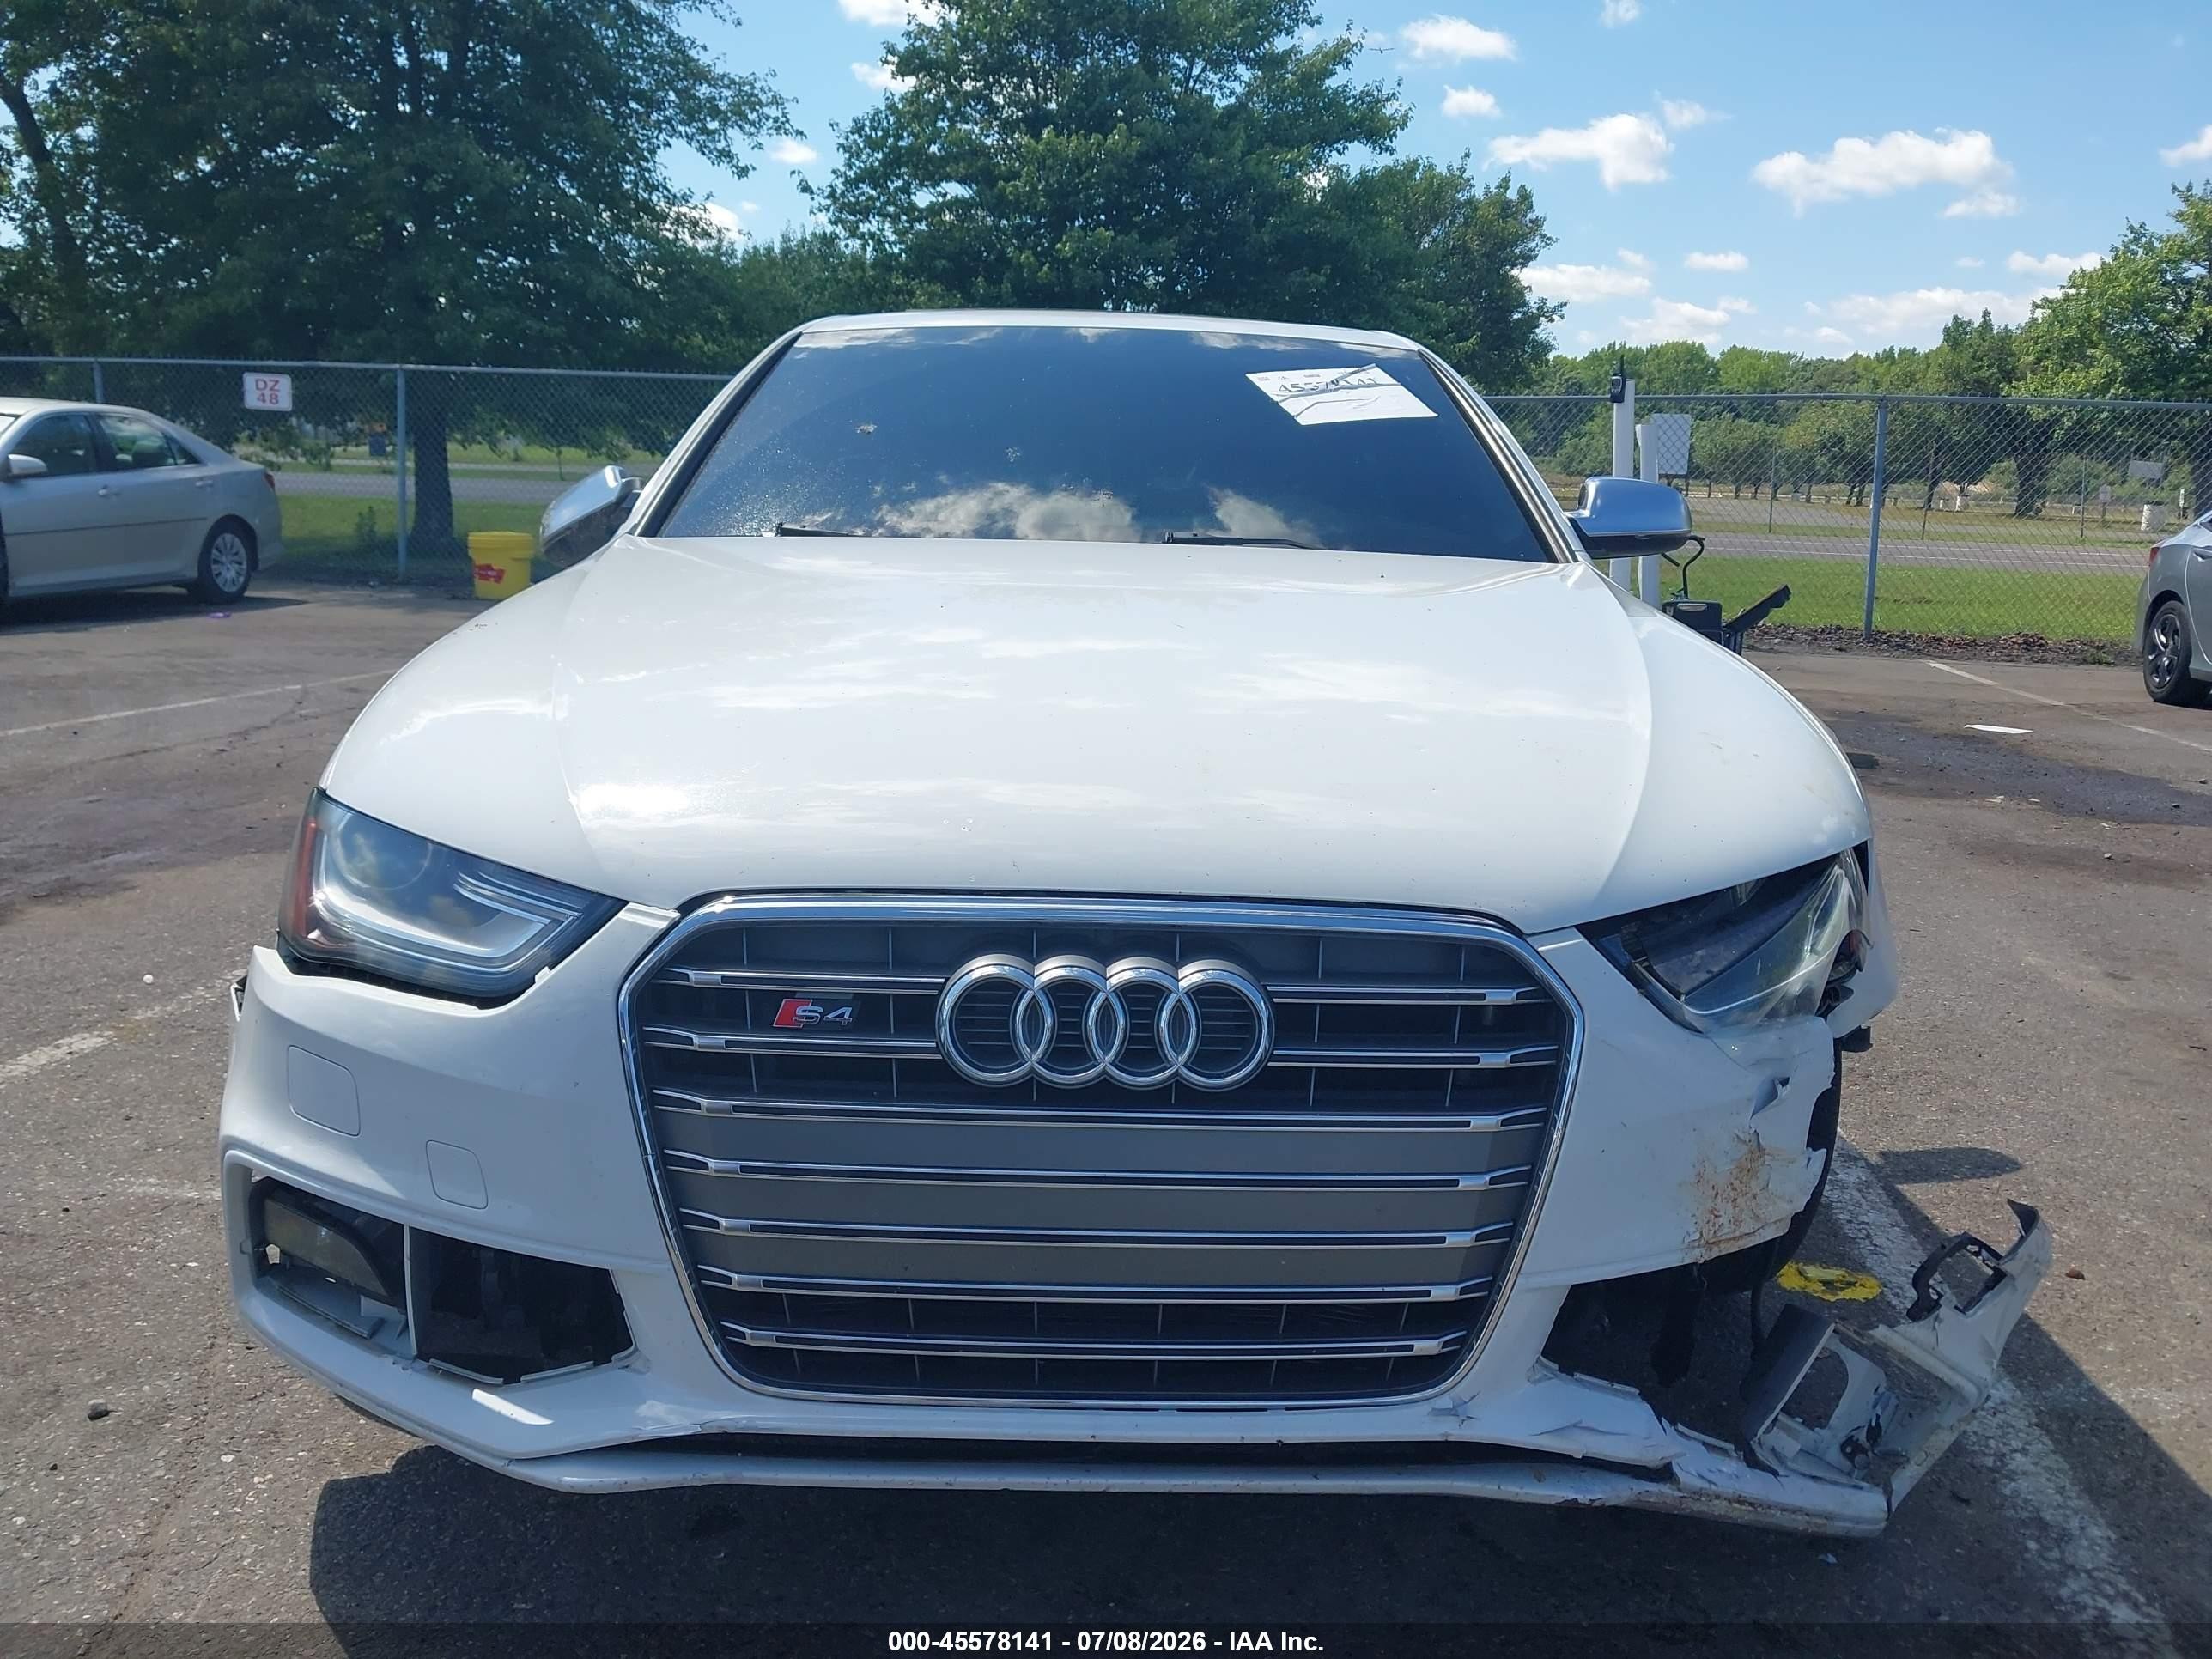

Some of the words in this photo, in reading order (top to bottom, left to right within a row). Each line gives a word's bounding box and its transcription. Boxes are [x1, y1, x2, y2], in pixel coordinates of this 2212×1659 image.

[255, 378, 280, 392] DZ
[257, 392, 279, 405] 48
[792, 1005, 854, 1026] S4
